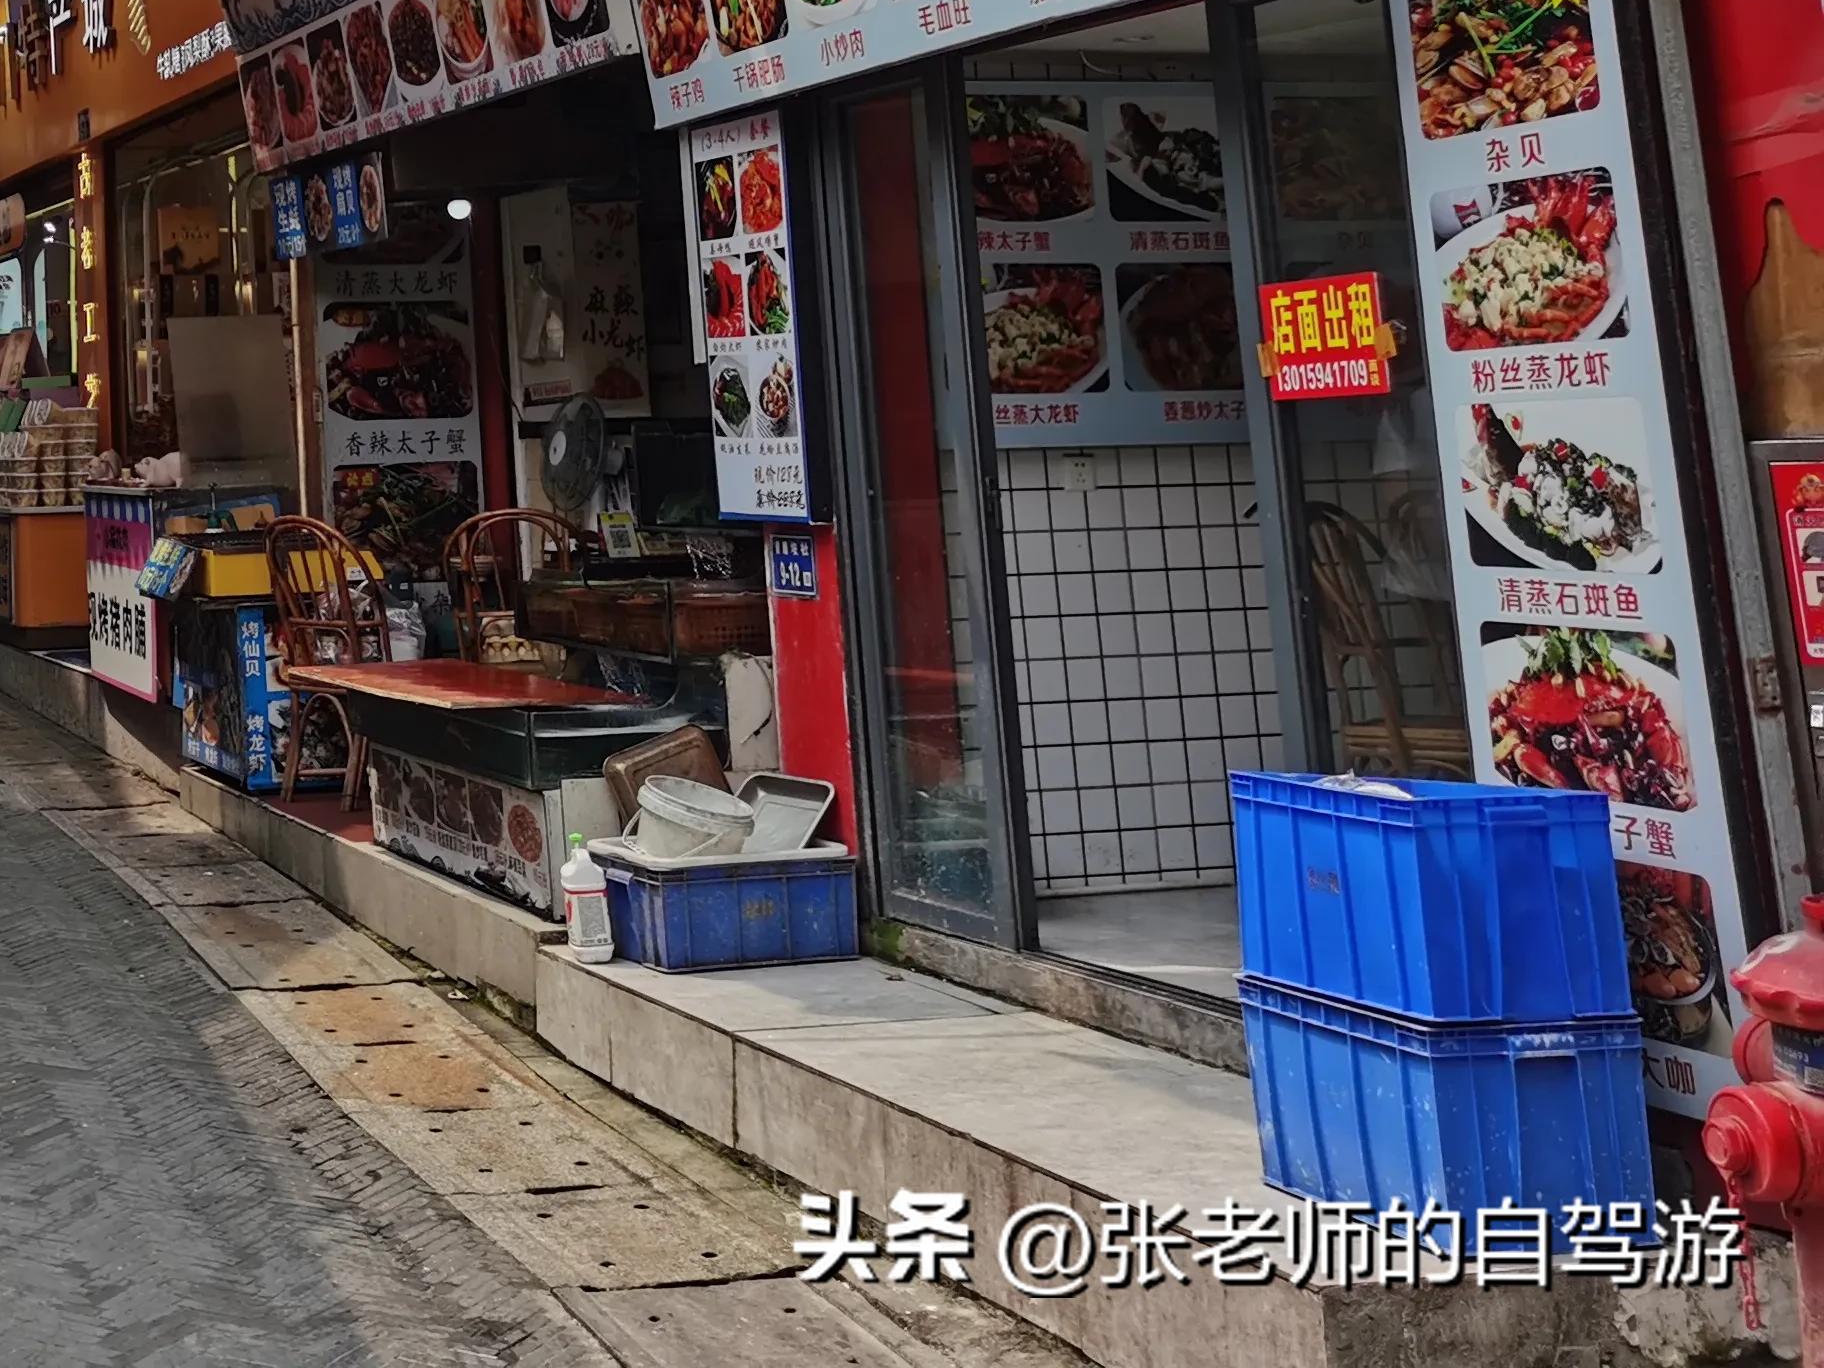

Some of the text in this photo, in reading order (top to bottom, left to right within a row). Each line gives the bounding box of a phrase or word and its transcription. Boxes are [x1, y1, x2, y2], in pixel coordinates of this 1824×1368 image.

[819, 28, 865, 66] 小炒肉
[732, 54, 785, 93] 干锅肥肠
[669, 78, 705, 110] 辣子鸡
[1485, 134, 1547, 172] 杂贝
[335, 271, 459, 297] 清蒸大龙虾
[1270, 282, 1376, 354] 店面出租
[1277, 363, 1368, 393] 13015941709
[1470, 354, 1611, 394] 粉丝蒸龙虾
[346, 428, 467, 458] 香辣太子蟹
[1497, 577, 1644, 624] 清蒸石斑鱼
[1614, 813, 1676, 859] 子蟹
